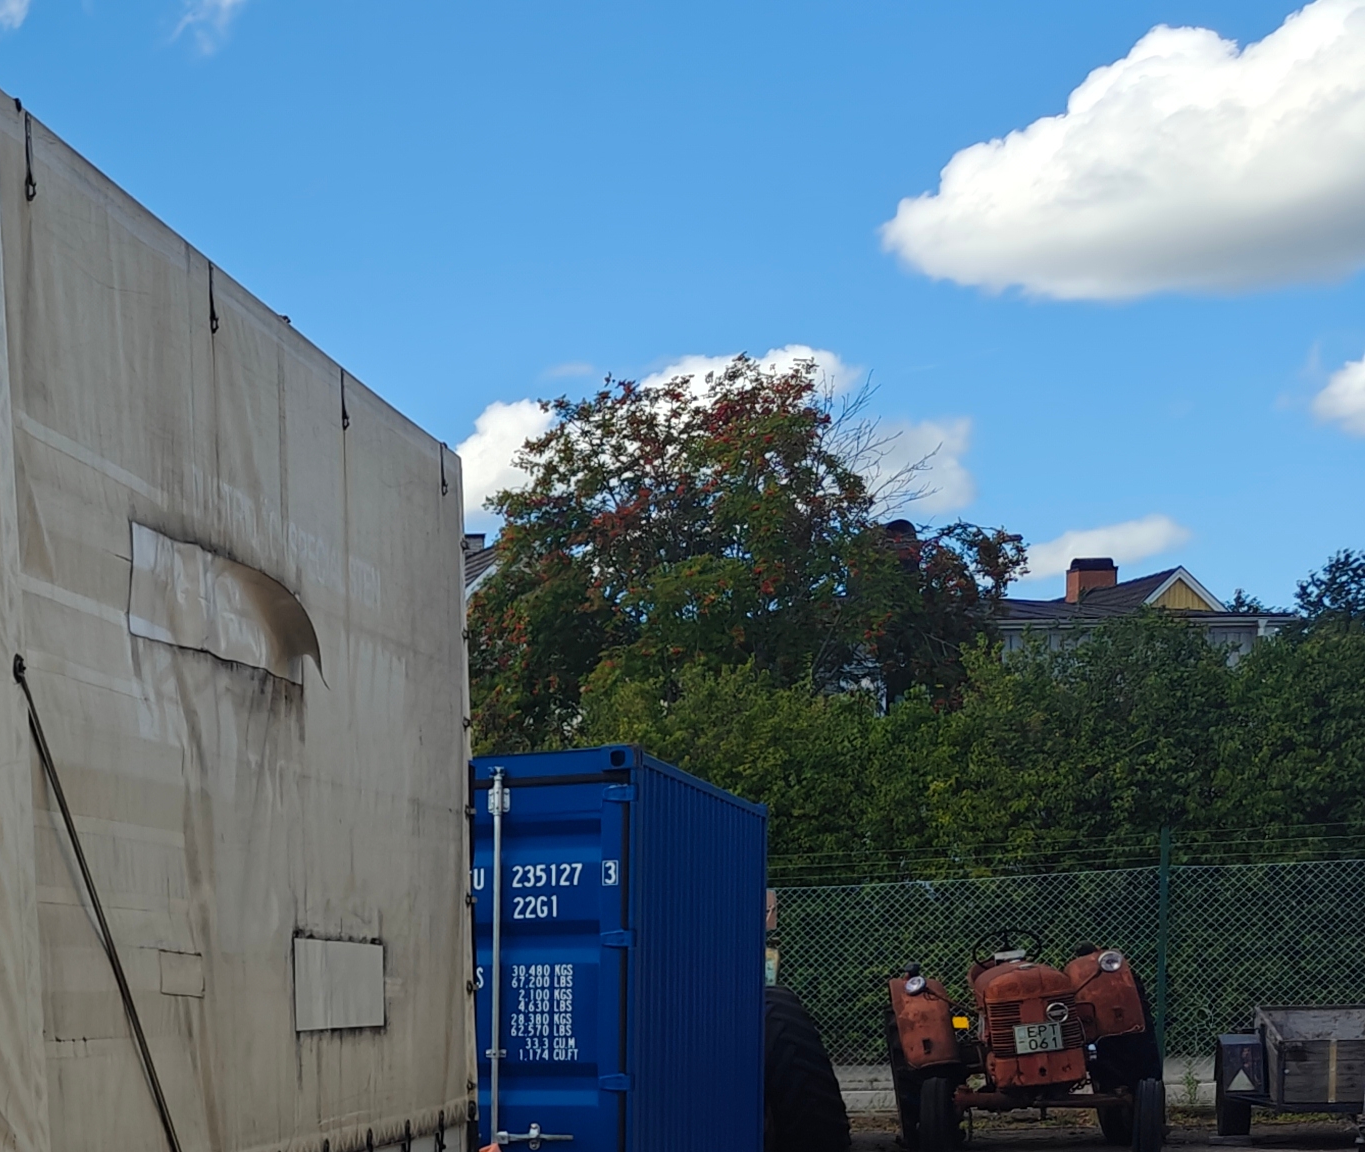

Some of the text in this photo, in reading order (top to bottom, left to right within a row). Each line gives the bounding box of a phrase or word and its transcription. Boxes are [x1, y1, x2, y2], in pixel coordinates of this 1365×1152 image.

[512, 863, 583, 888] 235127
[604, 861, 616, 884] 3
[513, 895, 558, 919] 22G1
[554, 964, 573, 977] KGS
[554, 975, 573, 988] LBS
[554, 988, 573, 1001] KGS
[554, 1000, 572, 1012] LBS
[553, 1012, 572, 1025] KGS
[553, 1024, 572, 1036] LBS
[1027, 1024, 1057, 1038] EPT
[1029, 1037, 1057, 1050] 061
